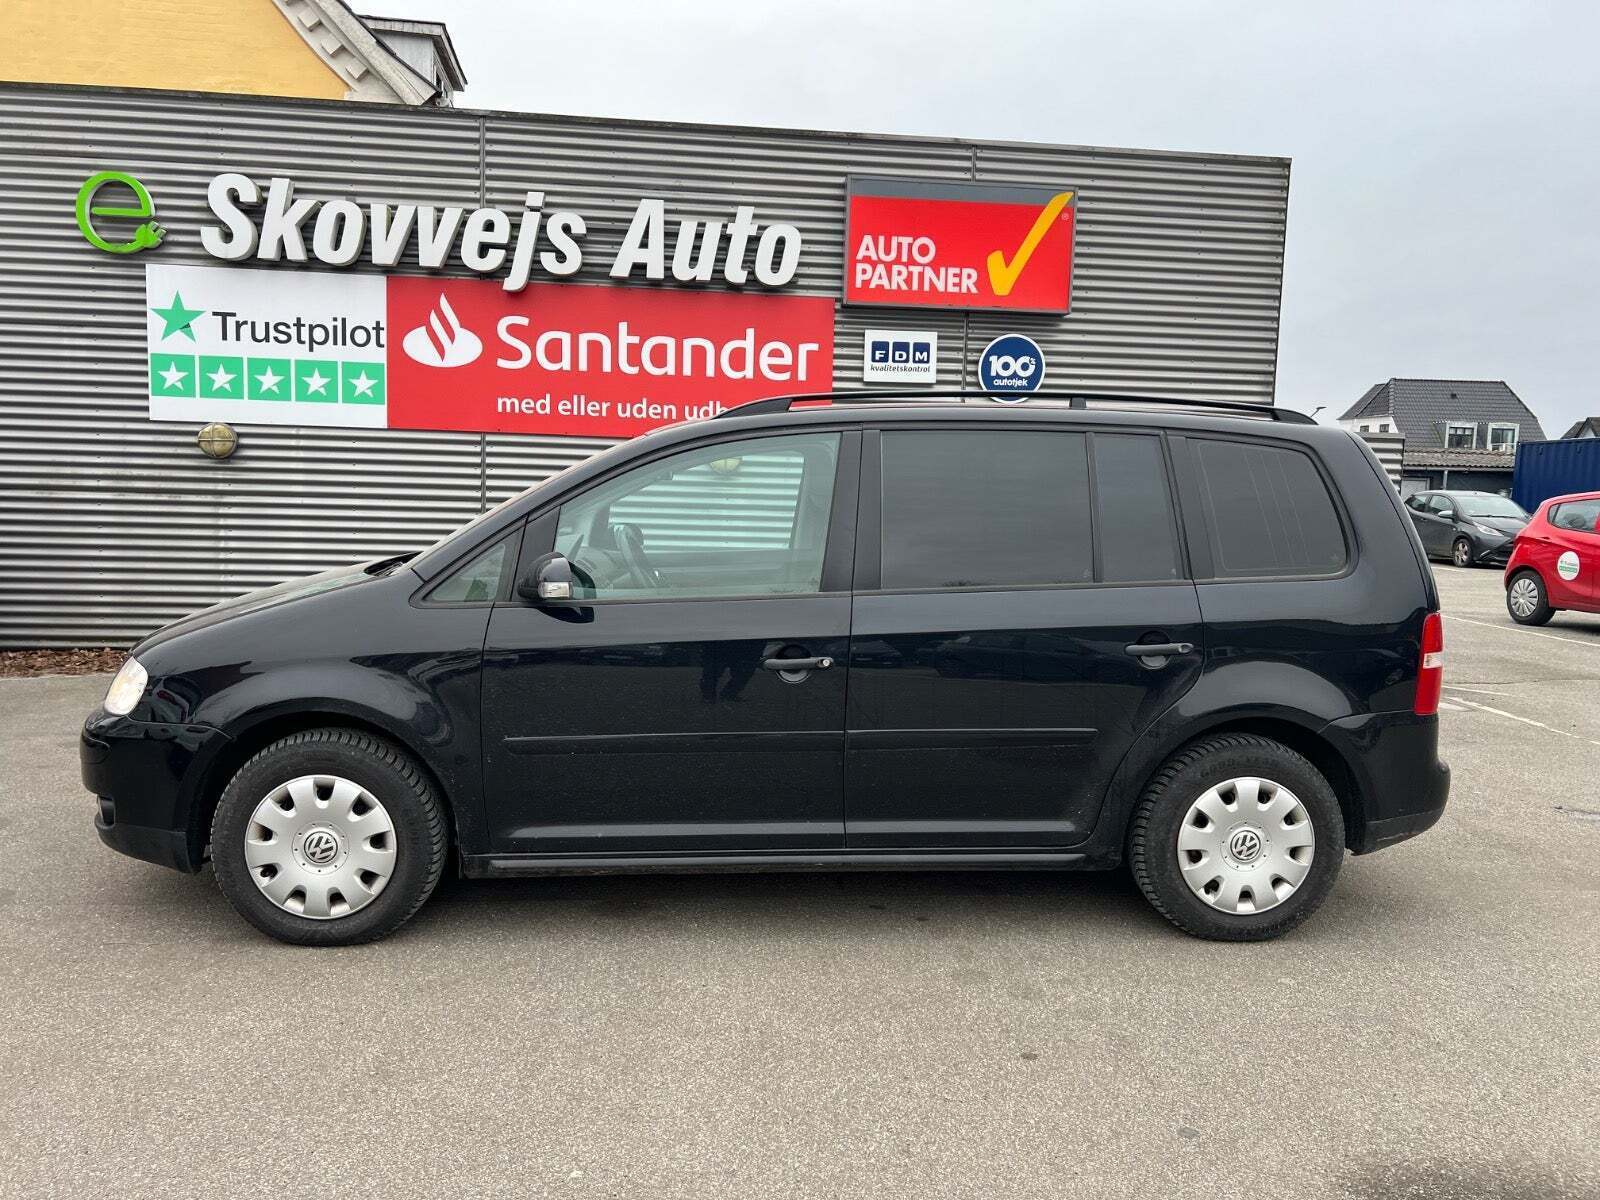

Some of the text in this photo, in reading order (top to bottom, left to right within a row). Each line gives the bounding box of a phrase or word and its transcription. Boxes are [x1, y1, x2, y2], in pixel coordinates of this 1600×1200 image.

[200, 173, 587, 293] Skovvejs
[608, 198, 802, 286] Auto
[855, 234, 937, 265] AUTO
[854, 262, 979, 294] PARTNER
[211, 311, 386, 353] Trustpilot
[496, 314, 820, 382] Santander
[874, 350, 929, 362] FDM
[870, 364, 931, 374] kvalitetskontrol
[993, 377, 1029, 388] autotjek
[497, 393, 551, 414] med
[557, 394, 611, 417] eller
[617, 398, 677, 420] uden
